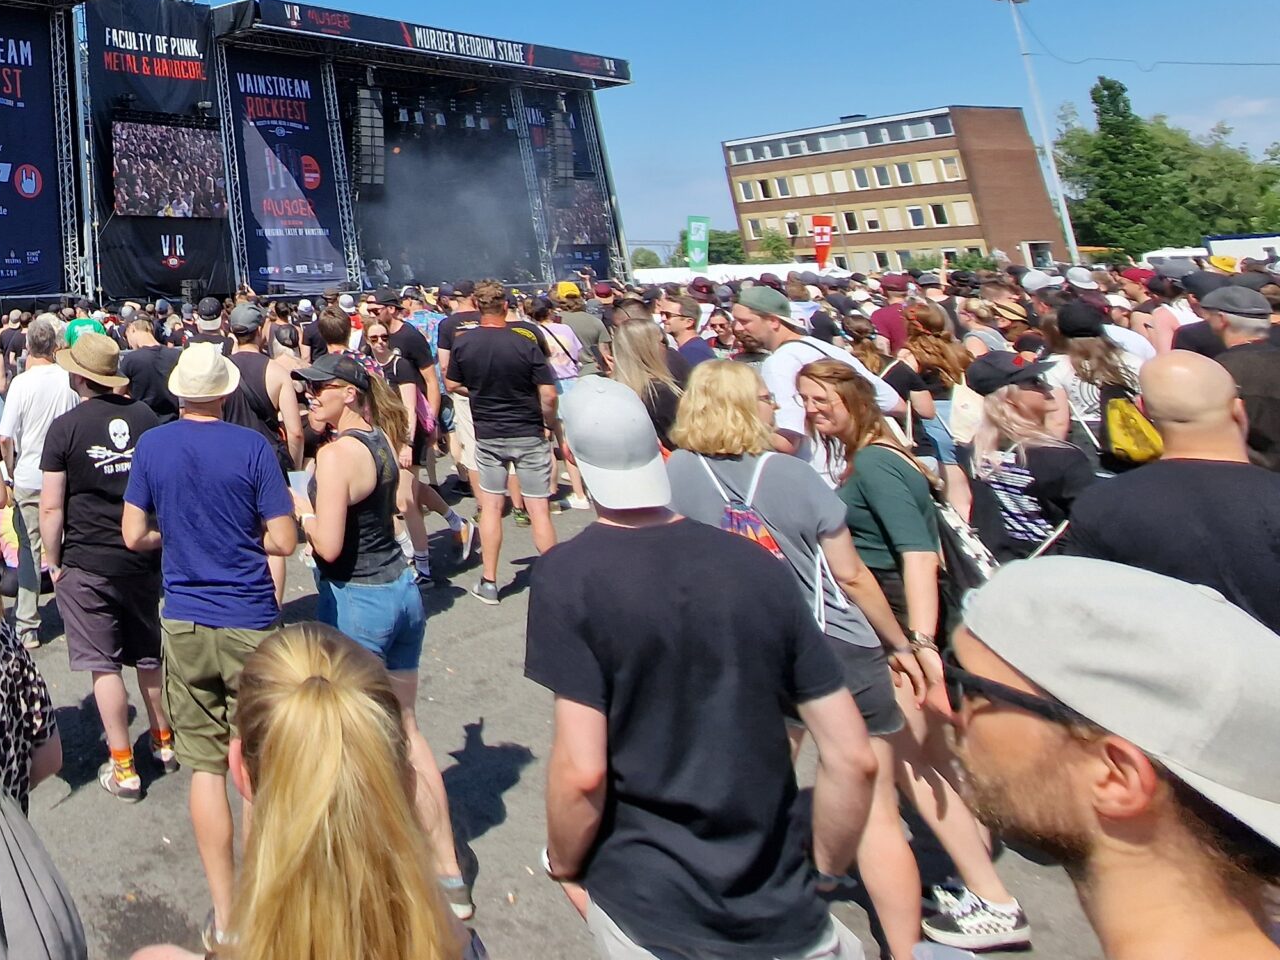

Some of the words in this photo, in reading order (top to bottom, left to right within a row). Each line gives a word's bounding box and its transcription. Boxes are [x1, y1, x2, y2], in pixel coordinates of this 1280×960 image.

[105, 26, 152, 53] FACULTY
[155, 34, 169, 55] OF
[170, 37, 204, 60] PUNK,
[414, 26, 457, 54] MURDER
[457, 34, 497, 60] REDRUM
[497, 41, 526, 64] STAGE
[104, 51, 139, 74] METAL
[142, 56, 151, 77] &
[153, 57, 207, 81] HARDCORE
[236, 72, 312, 99] VAINSTREAM
[246, 96, 308, 123] ROCKFEST
[103, 464, 115, 475] SEA
